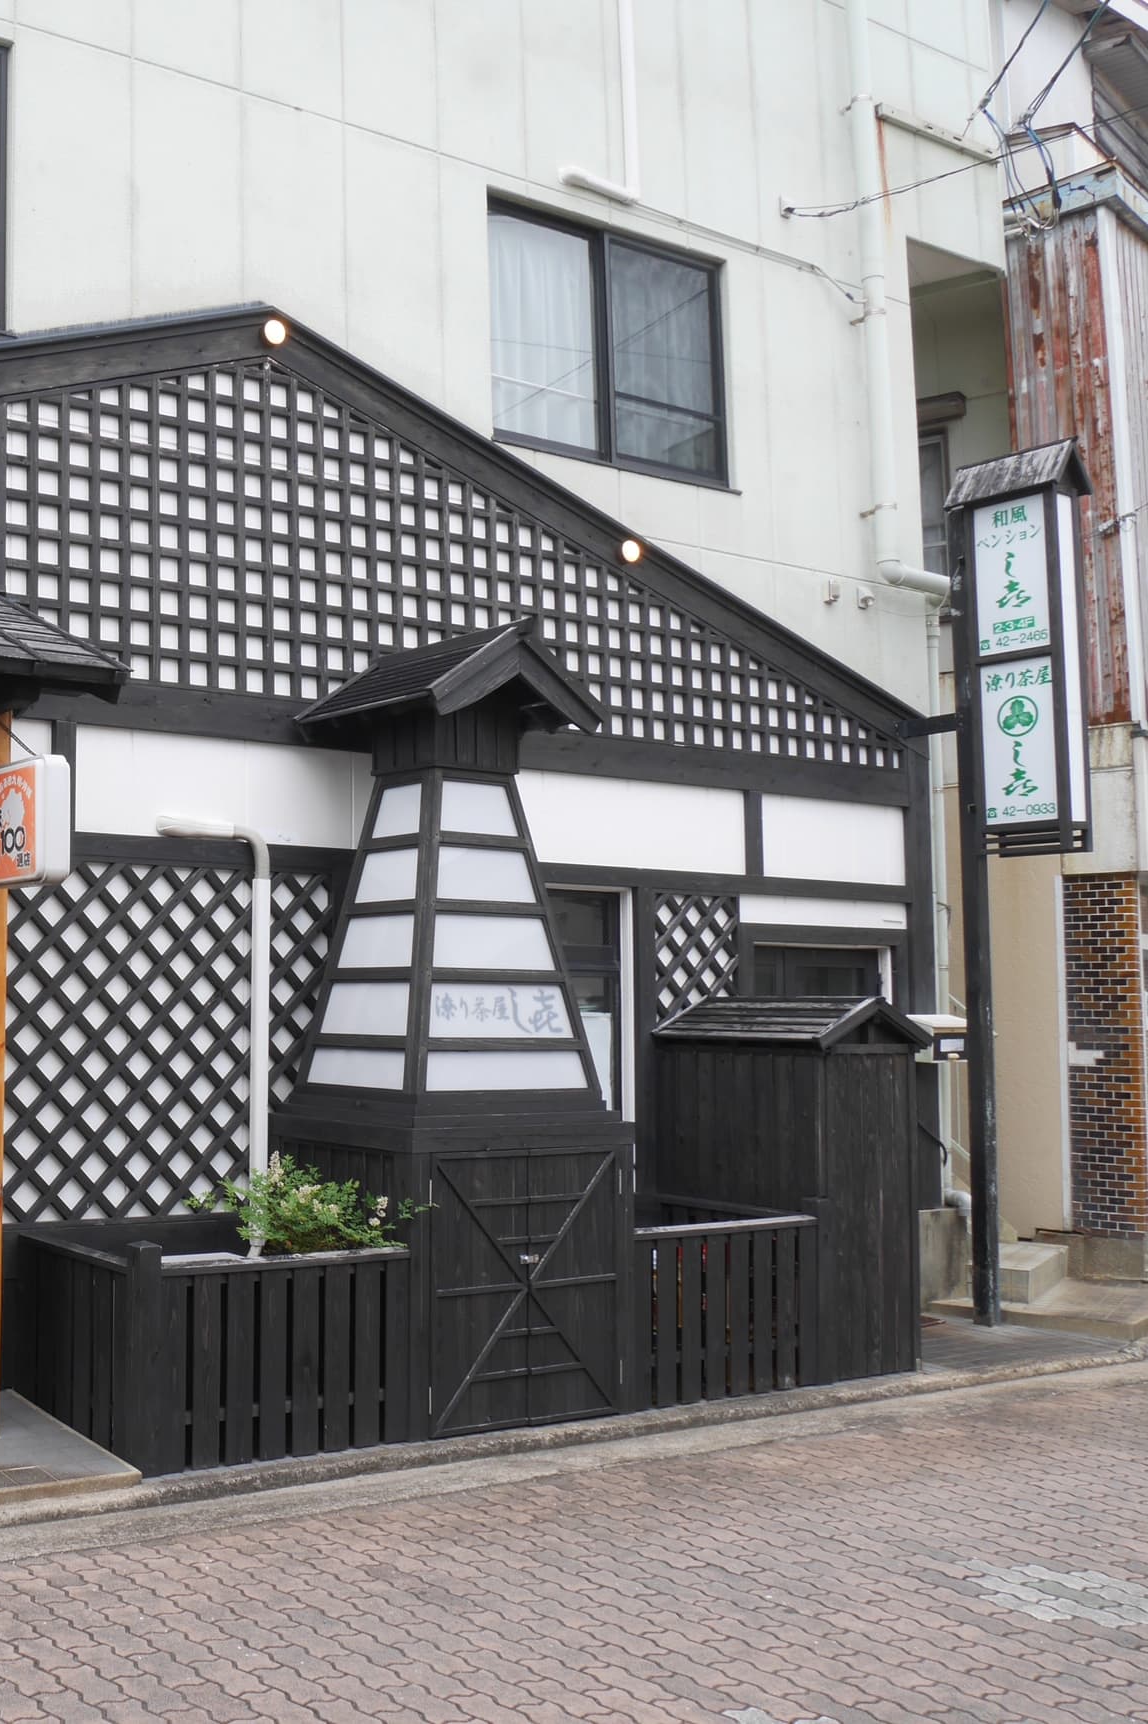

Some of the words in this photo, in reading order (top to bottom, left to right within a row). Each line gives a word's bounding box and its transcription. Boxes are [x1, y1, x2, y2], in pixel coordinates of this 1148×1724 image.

[992, 505, 1027, 528] 和風
[977, 524, 1041, 548] ペンション
